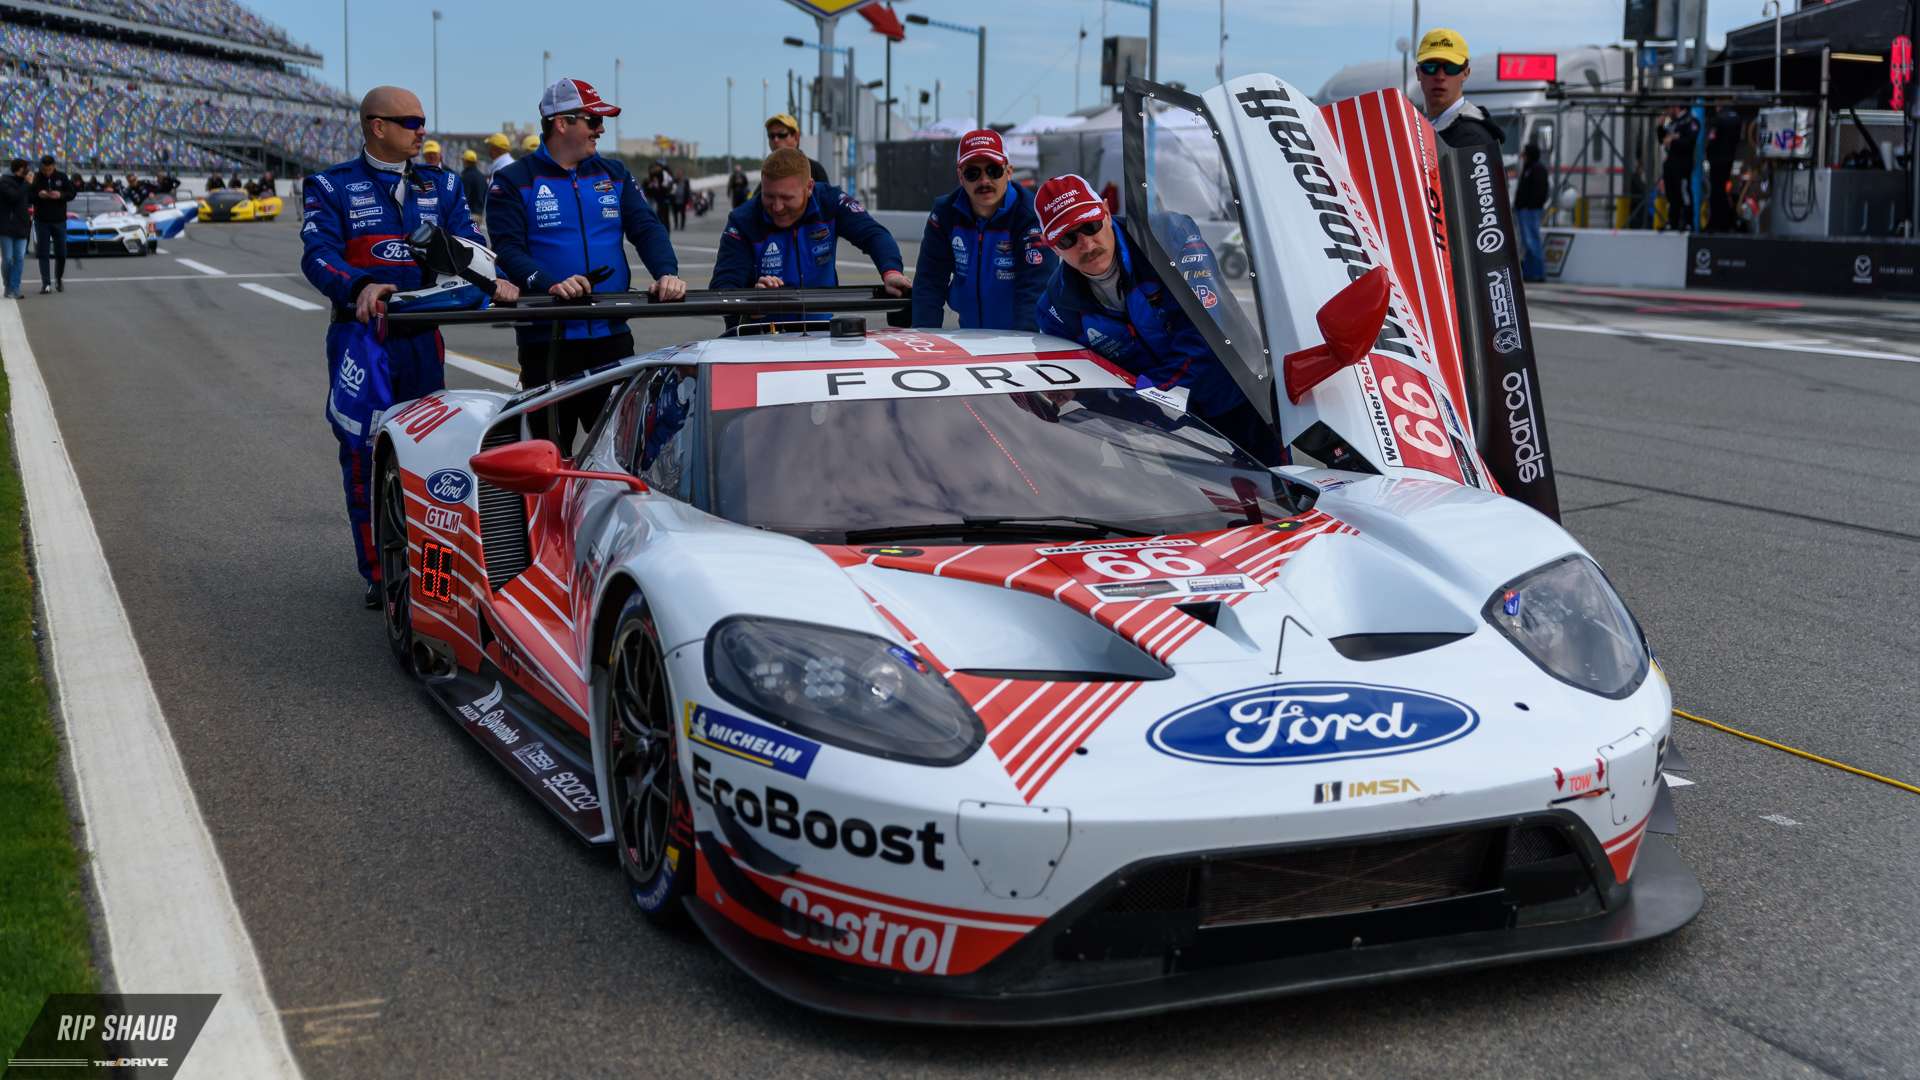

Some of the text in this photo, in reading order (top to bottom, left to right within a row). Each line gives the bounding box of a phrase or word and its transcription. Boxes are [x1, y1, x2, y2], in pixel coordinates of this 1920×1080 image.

[1341, 180, 1379, 251] PARTS
[1470, 152, 1499, 228] brembo
[826, 363, 1081, 396] FORD
[1358, 354, 1397, 462] WeatherTech
[1381, 375, 1451, 458] 66
[1502, 371, 1545, 484] sparco
[434, 473, 464, 499] Ford
[426, 509, 461, 532] GTLM
[1044, 539, 1195, 555] WeatherTech
[422, 543, 452, 602] 66
[1082, 547, 1206, 580] 66
[709, 722, 803, 764] MICHELIN
[1225, 692, 1417, 754] Ford
[1349, 777, 1421, 799] IMSA
[1569, 770, 1592, 792] TOW
[692, 753, 945, 871] EcoBoost
[780, 887, 958, 976] Castrol
